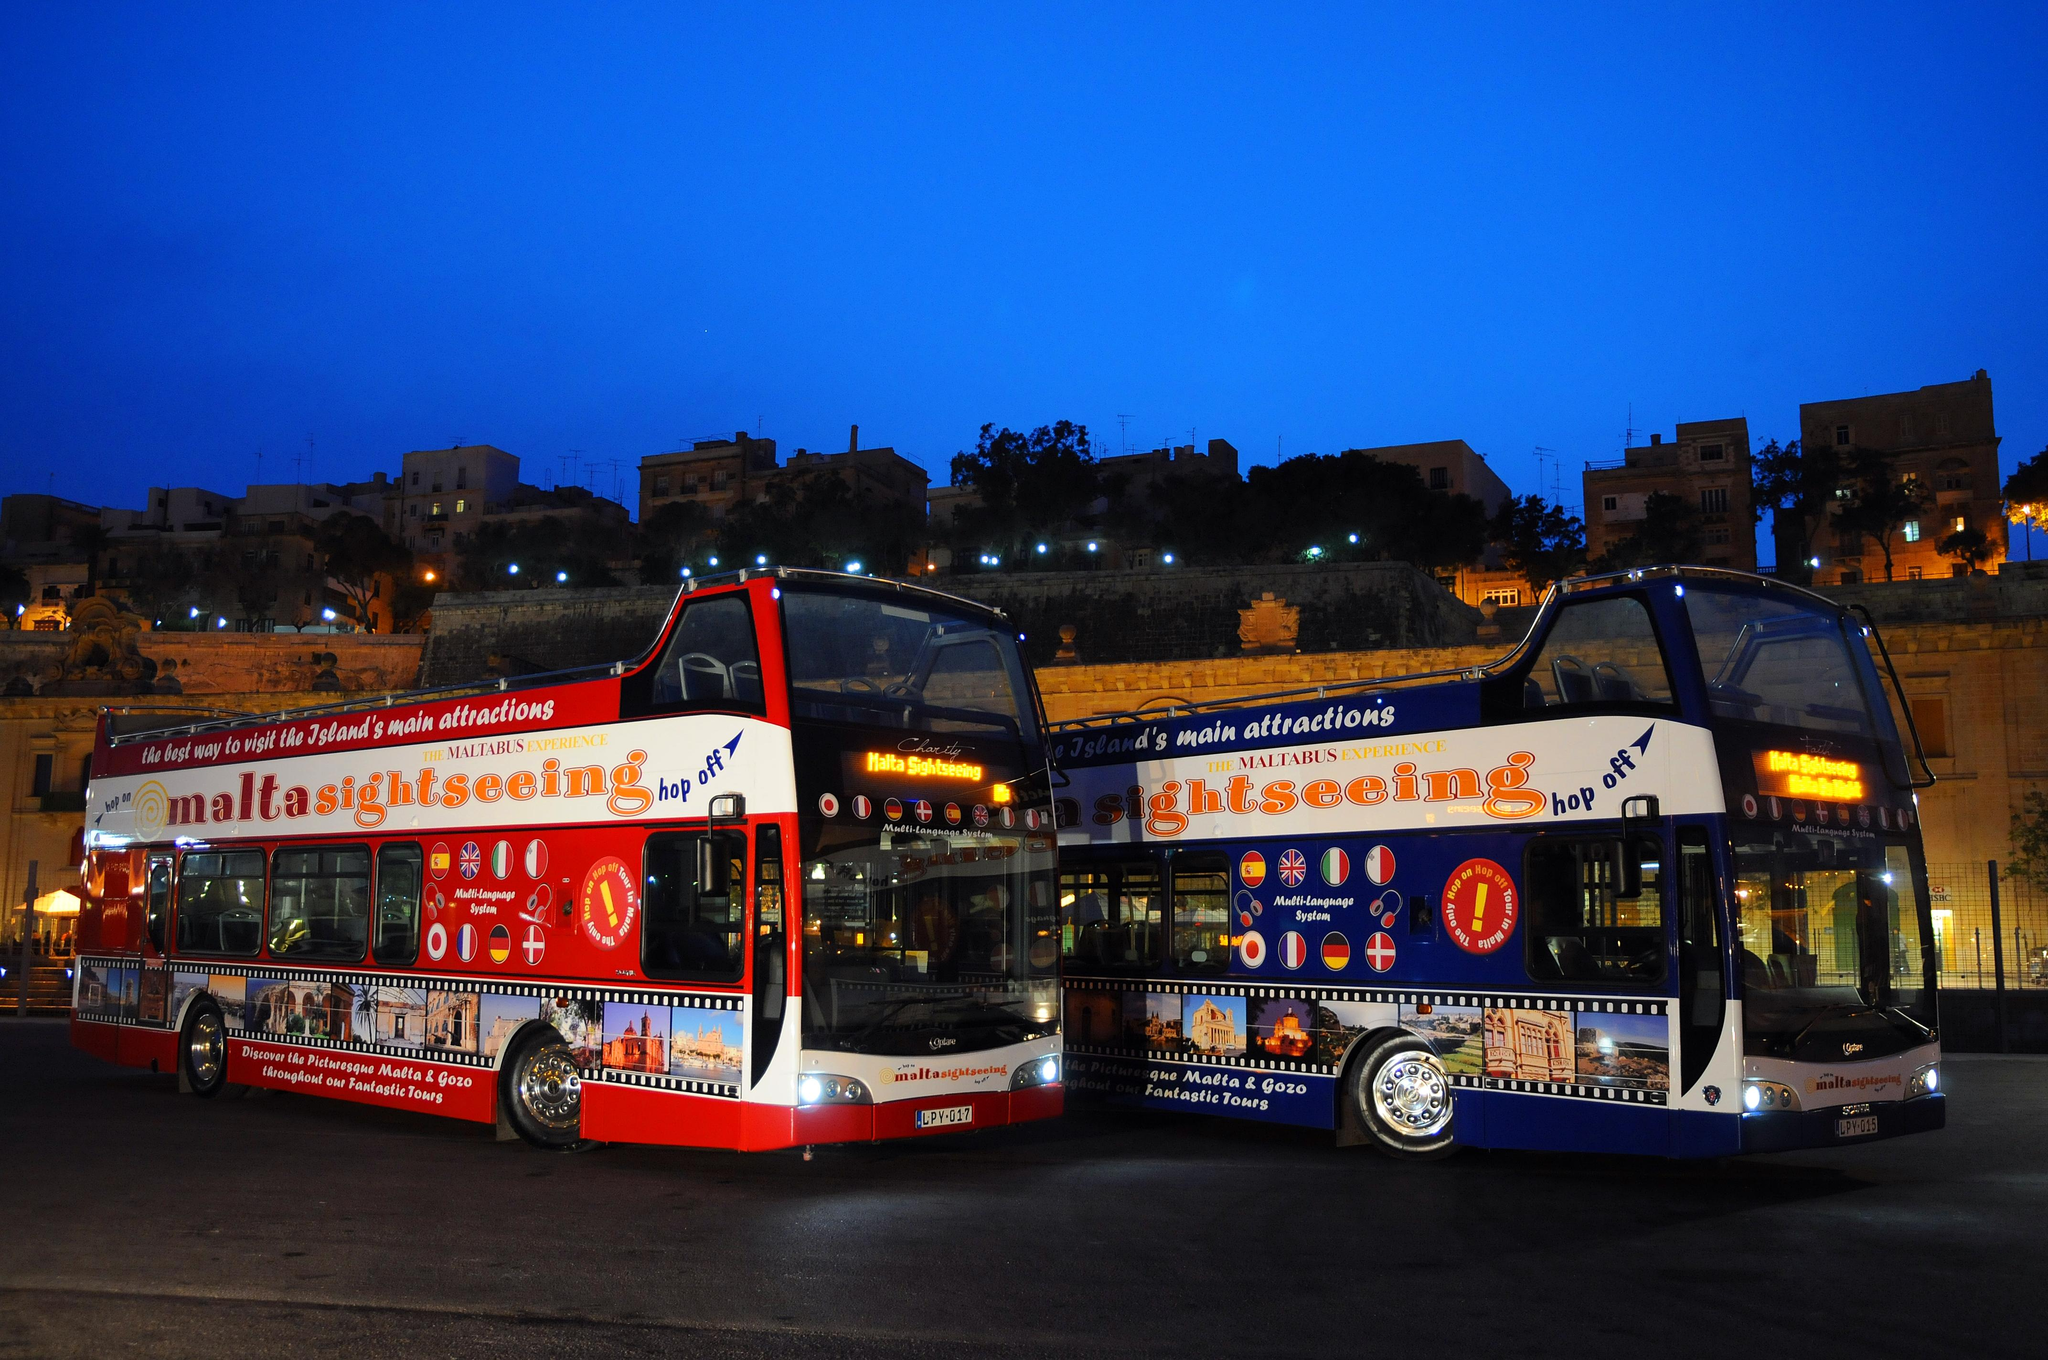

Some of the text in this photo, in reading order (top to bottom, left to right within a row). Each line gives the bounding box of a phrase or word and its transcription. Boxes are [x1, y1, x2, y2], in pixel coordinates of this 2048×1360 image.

[142, 698, 555, 765] the best way to visit the Island's main attractions
[1070, 726, 1168, 759] Island's
[1176, 720, 1237, 748] main
[1243, 705, 1396, 740] attractions
[422, 733, 609, 763] THE MALTABUS EXPERIENCE
[897, 737, 976, 763] Charity
[1206, 739, 1447, 773] THE MALTABUS EXPERIENCE
[658, 748, 724, 804] hop off
[867, 752, 982, 781] Malta Sightseeing
[1552, 749, 1636, 816] hop off
[105, 791, 132, 813] hop on
[882, 823, 993, 839] Multi-Language System
[592, 864, 606, 880] Hop
[607, 862, 619, 873] off
[618, 866, 631, 889] Tour
[1461, 868, 1473, 880] on
[1475, 865, 1493, 877] Hop
[586, 880, 594, 895] on
[1447, 878, 1461, 900] Hop
[1494, 874, 1508, 888] off
[454, 888, 516, 904] Multi-Language
[1274, 895, 1354, 910] Multi-Language
[1503, 888, 1512, 916] Tour
[469, 901, 498, 916] System
[583, 897, 591, 920] Hop
[1295, 909, 1332, 922] System
[1446, 903, 1457, 927] only
[587, 921, 601, 941] only
[618, 906, 635, 937] Malta
[601, 935, 615, 947] The
[1455, 928, 1470, 947] The
[1478, 930, 1504, 949] Malta
[241, 1045, 473, 1088] Discover the Picturesque Malta & Gozo
[262, 1064, 443, 1104] throughout our Fantastic Tours
[1090, 1061, 1179, 1083] Picturesque
[1183, 1070, 1240, 1089] Malta
[1245, 1076, 1257, 1090] &
[1261, 1078, 1308, 1095] Gozo
[1145, 1083, 1219, 1104] Fantastic
[1222, 1092, 1269, 1111] Tours
